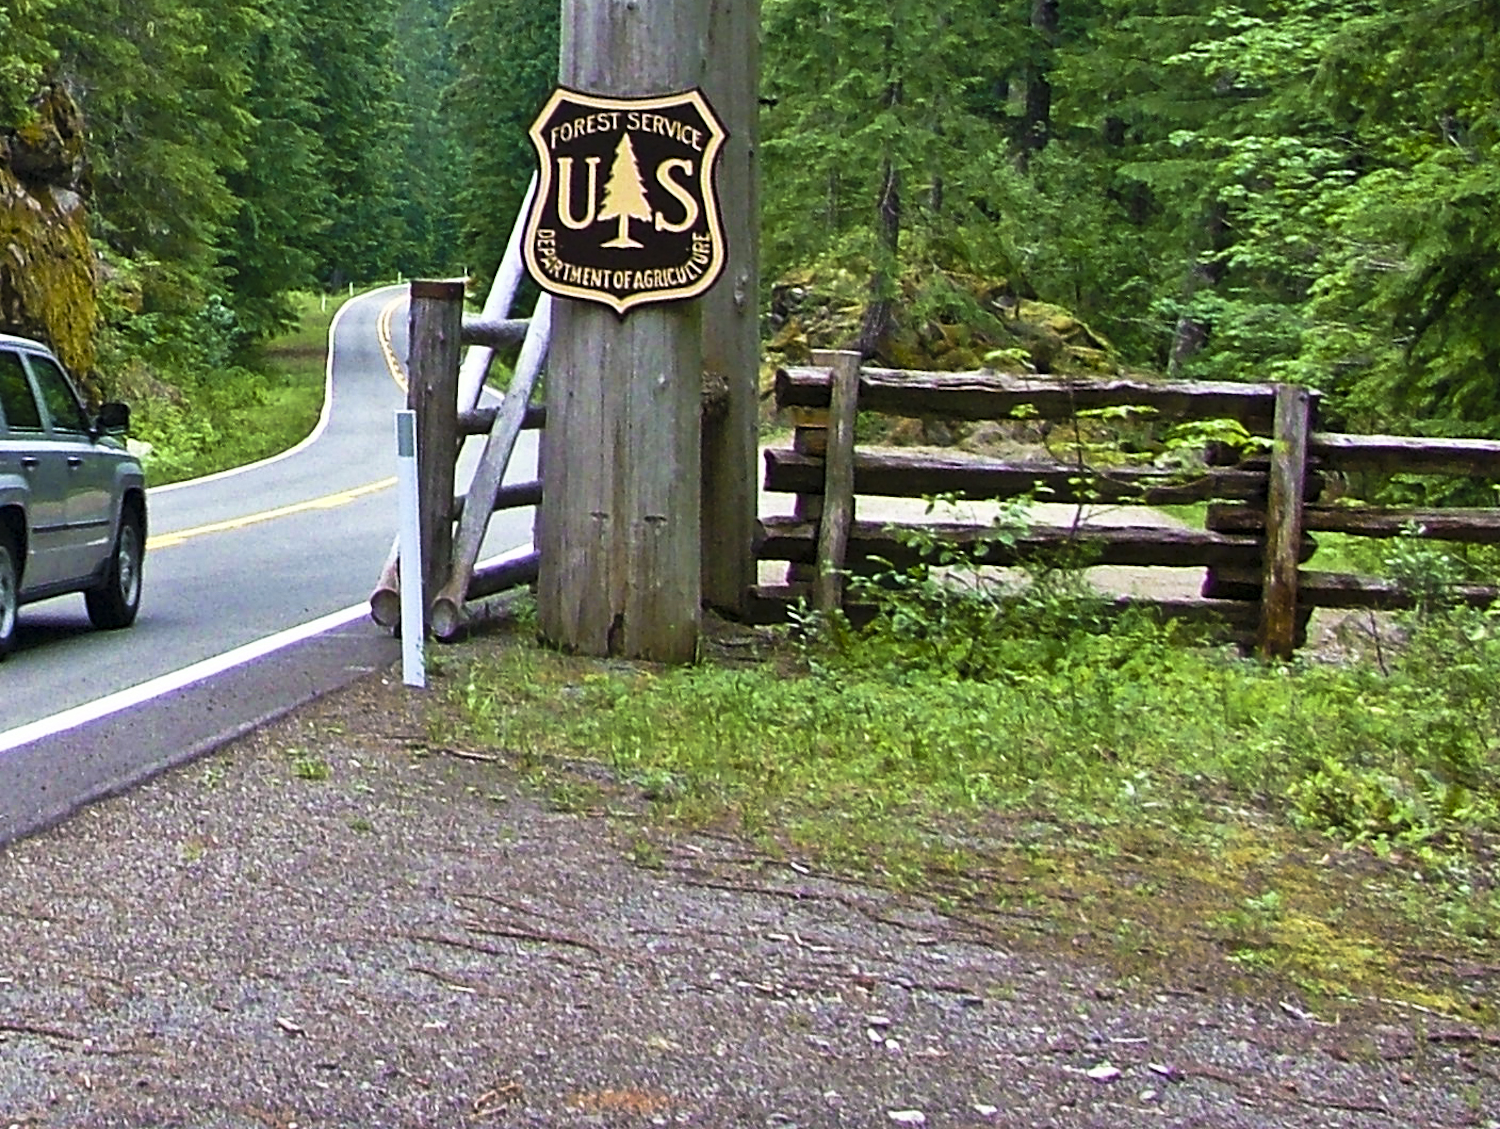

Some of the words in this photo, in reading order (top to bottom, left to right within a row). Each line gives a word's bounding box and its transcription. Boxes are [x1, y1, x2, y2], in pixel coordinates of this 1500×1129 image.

[551, 112, 620, 150] FOREST
[627, 112, 703, 152] SERVICE
[537, 228, 612, 288] DEPARTMENT
[612, 270, 633, 290] OF
[632, 231, 711, 290] AGRICULTURE
